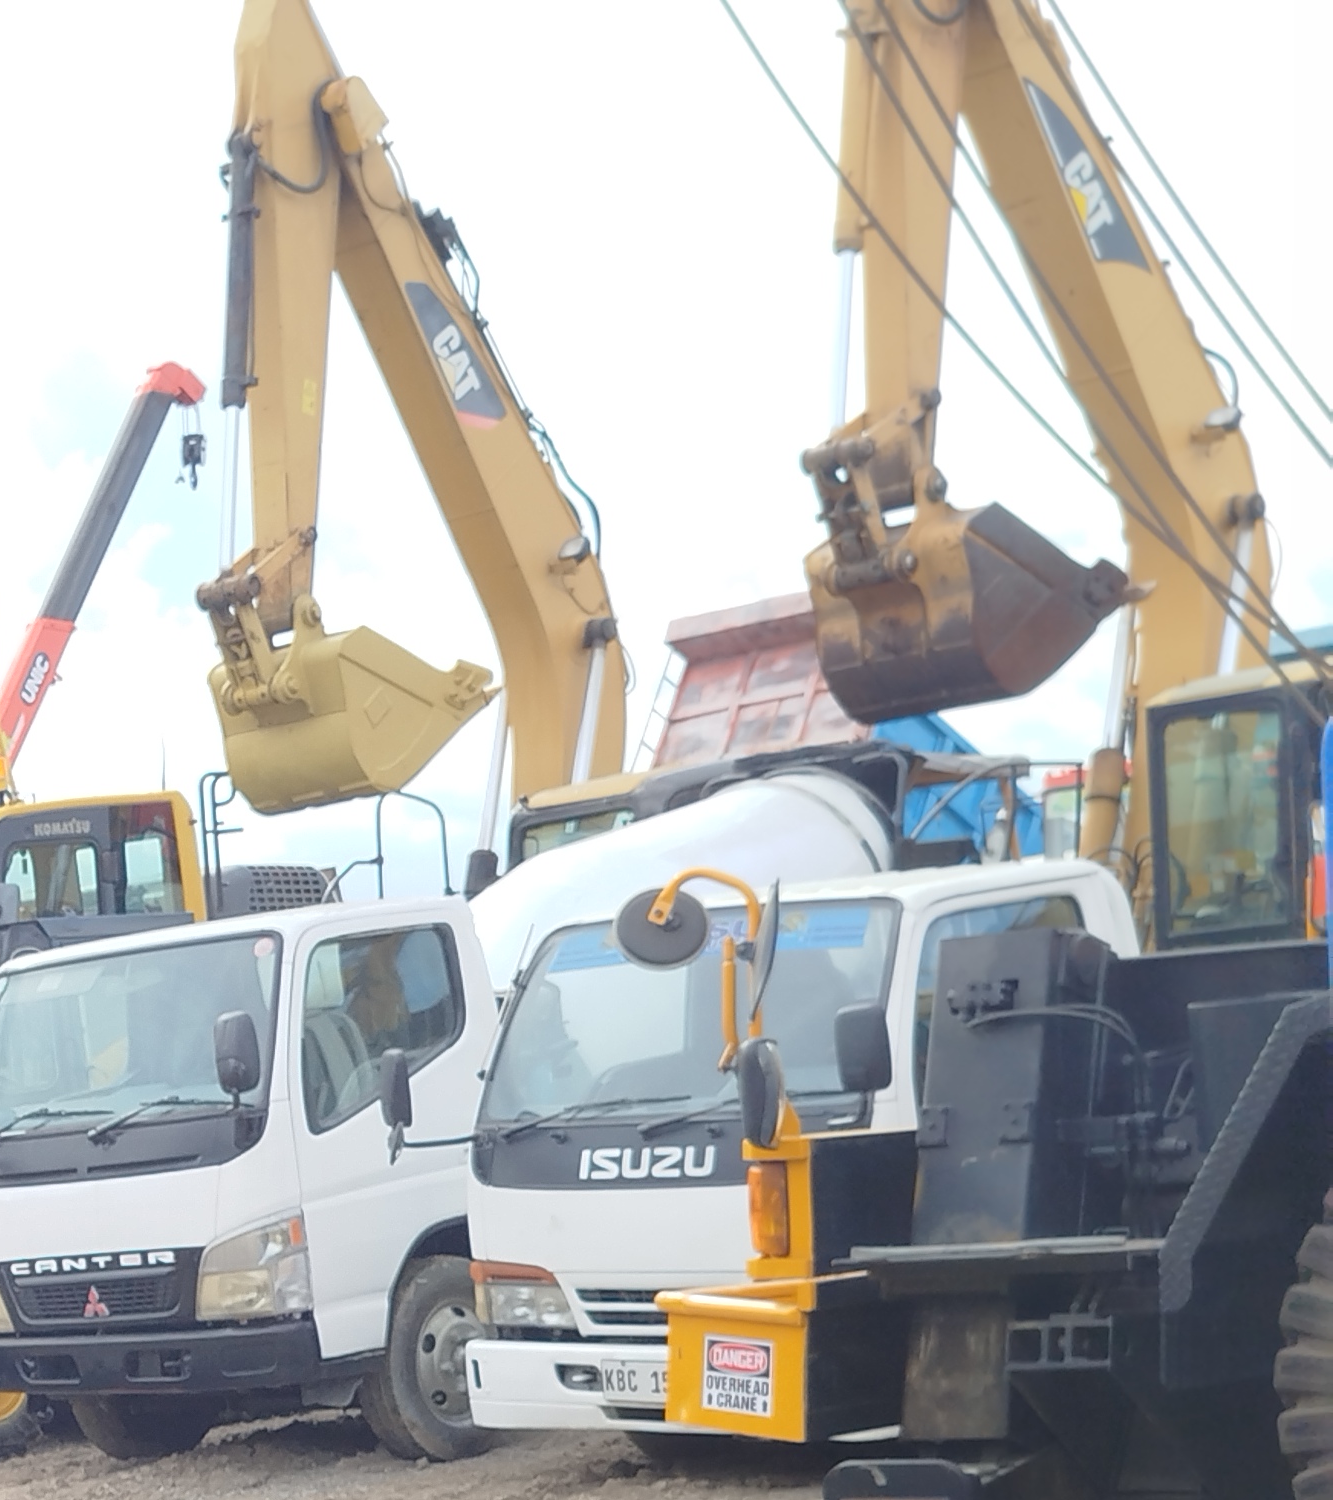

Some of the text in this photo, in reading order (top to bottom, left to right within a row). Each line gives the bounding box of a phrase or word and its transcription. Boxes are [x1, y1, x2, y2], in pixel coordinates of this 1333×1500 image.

[1064, 150, 1114, 236] CAT
[433, 323, 481, 401] CAT
[20, 653, 50, 705] UNIC
[33, 817, 91, 836] KOMATSU
[579, 1145, 716, 1180] ISUZU
[10, 1251, 176, 1275] CANTER
[712, 1346, 765, 1371] DANGER
[604, 1368, 638, 1393] KBC
[706, 1374, 770, 1397] OVERHEAD
[716, 1392, 757, 1412] CRANE
